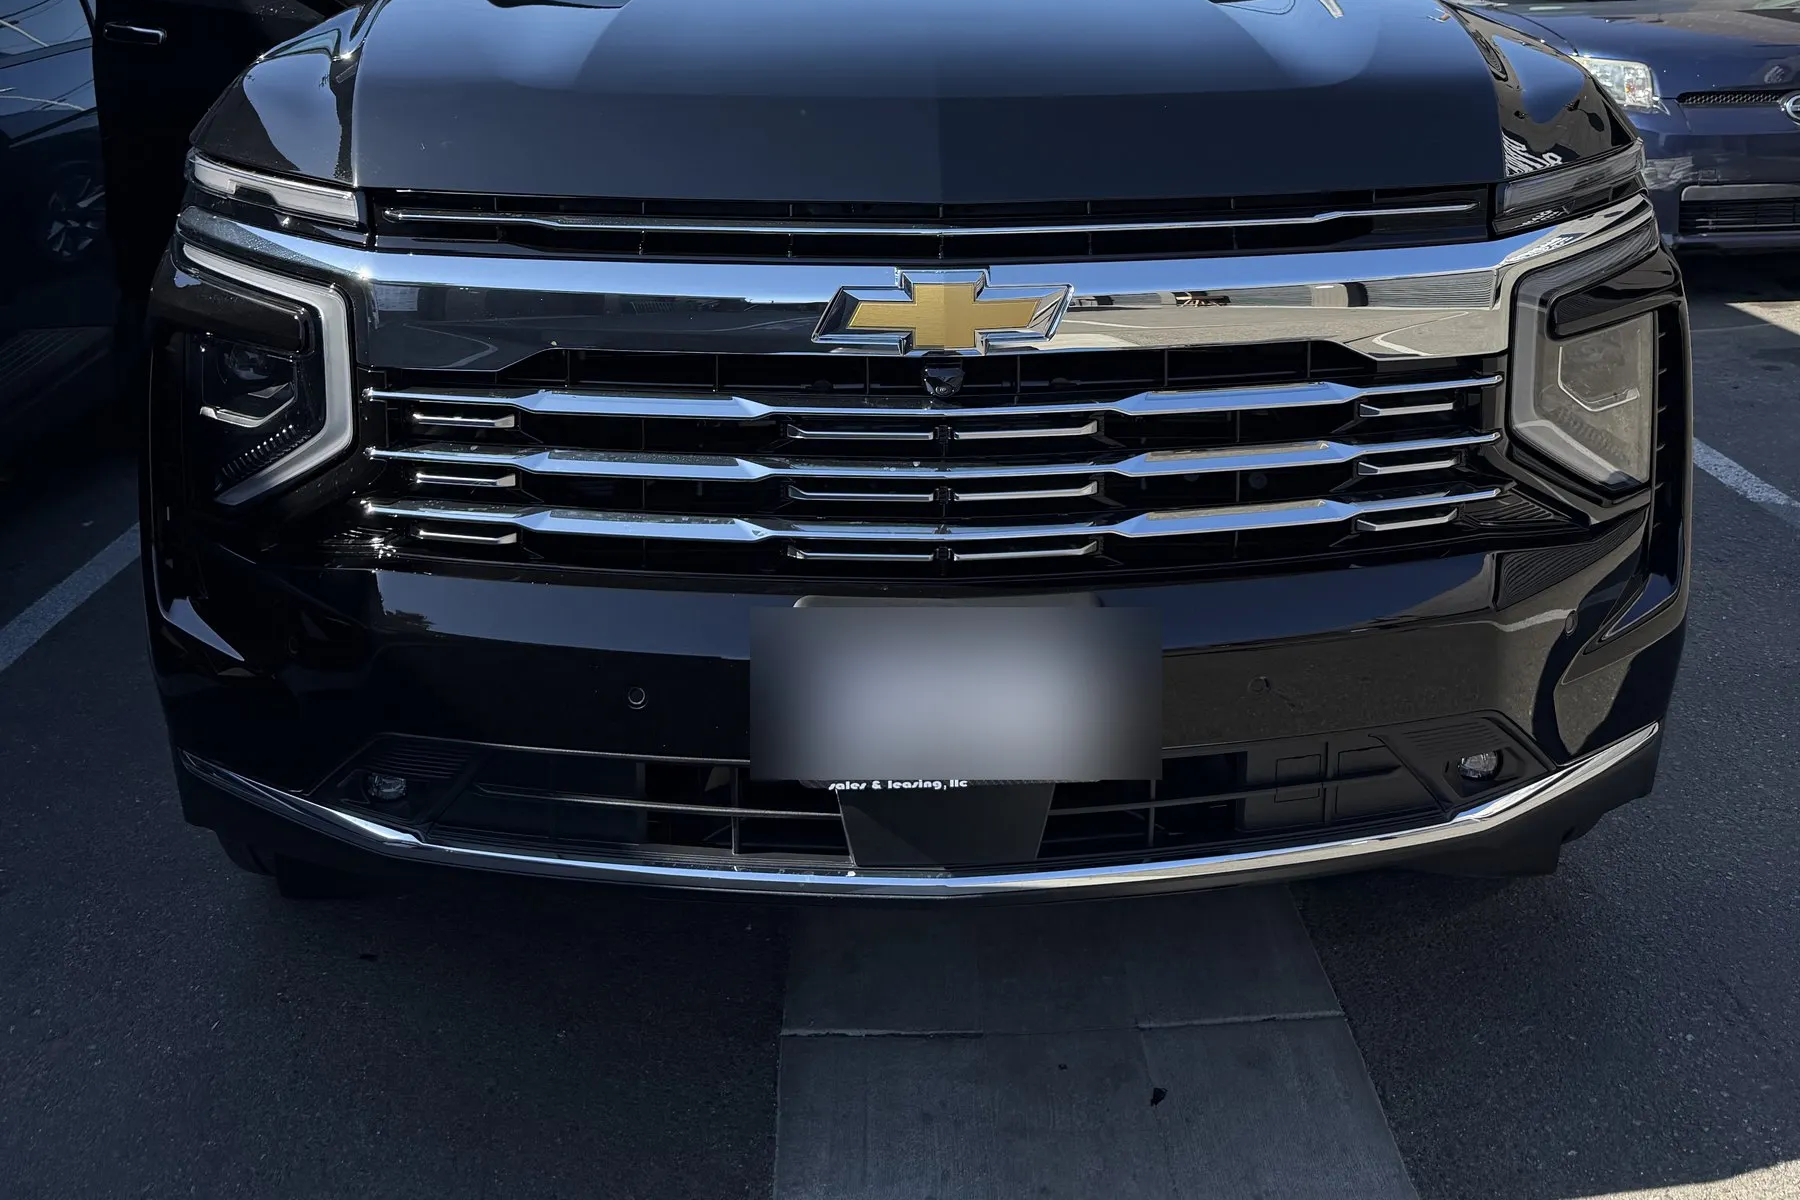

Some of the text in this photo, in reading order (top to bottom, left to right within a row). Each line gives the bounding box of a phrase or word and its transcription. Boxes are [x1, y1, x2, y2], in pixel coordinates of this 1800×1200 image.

[828, 779, 968, 791] sales & leasing, llc
